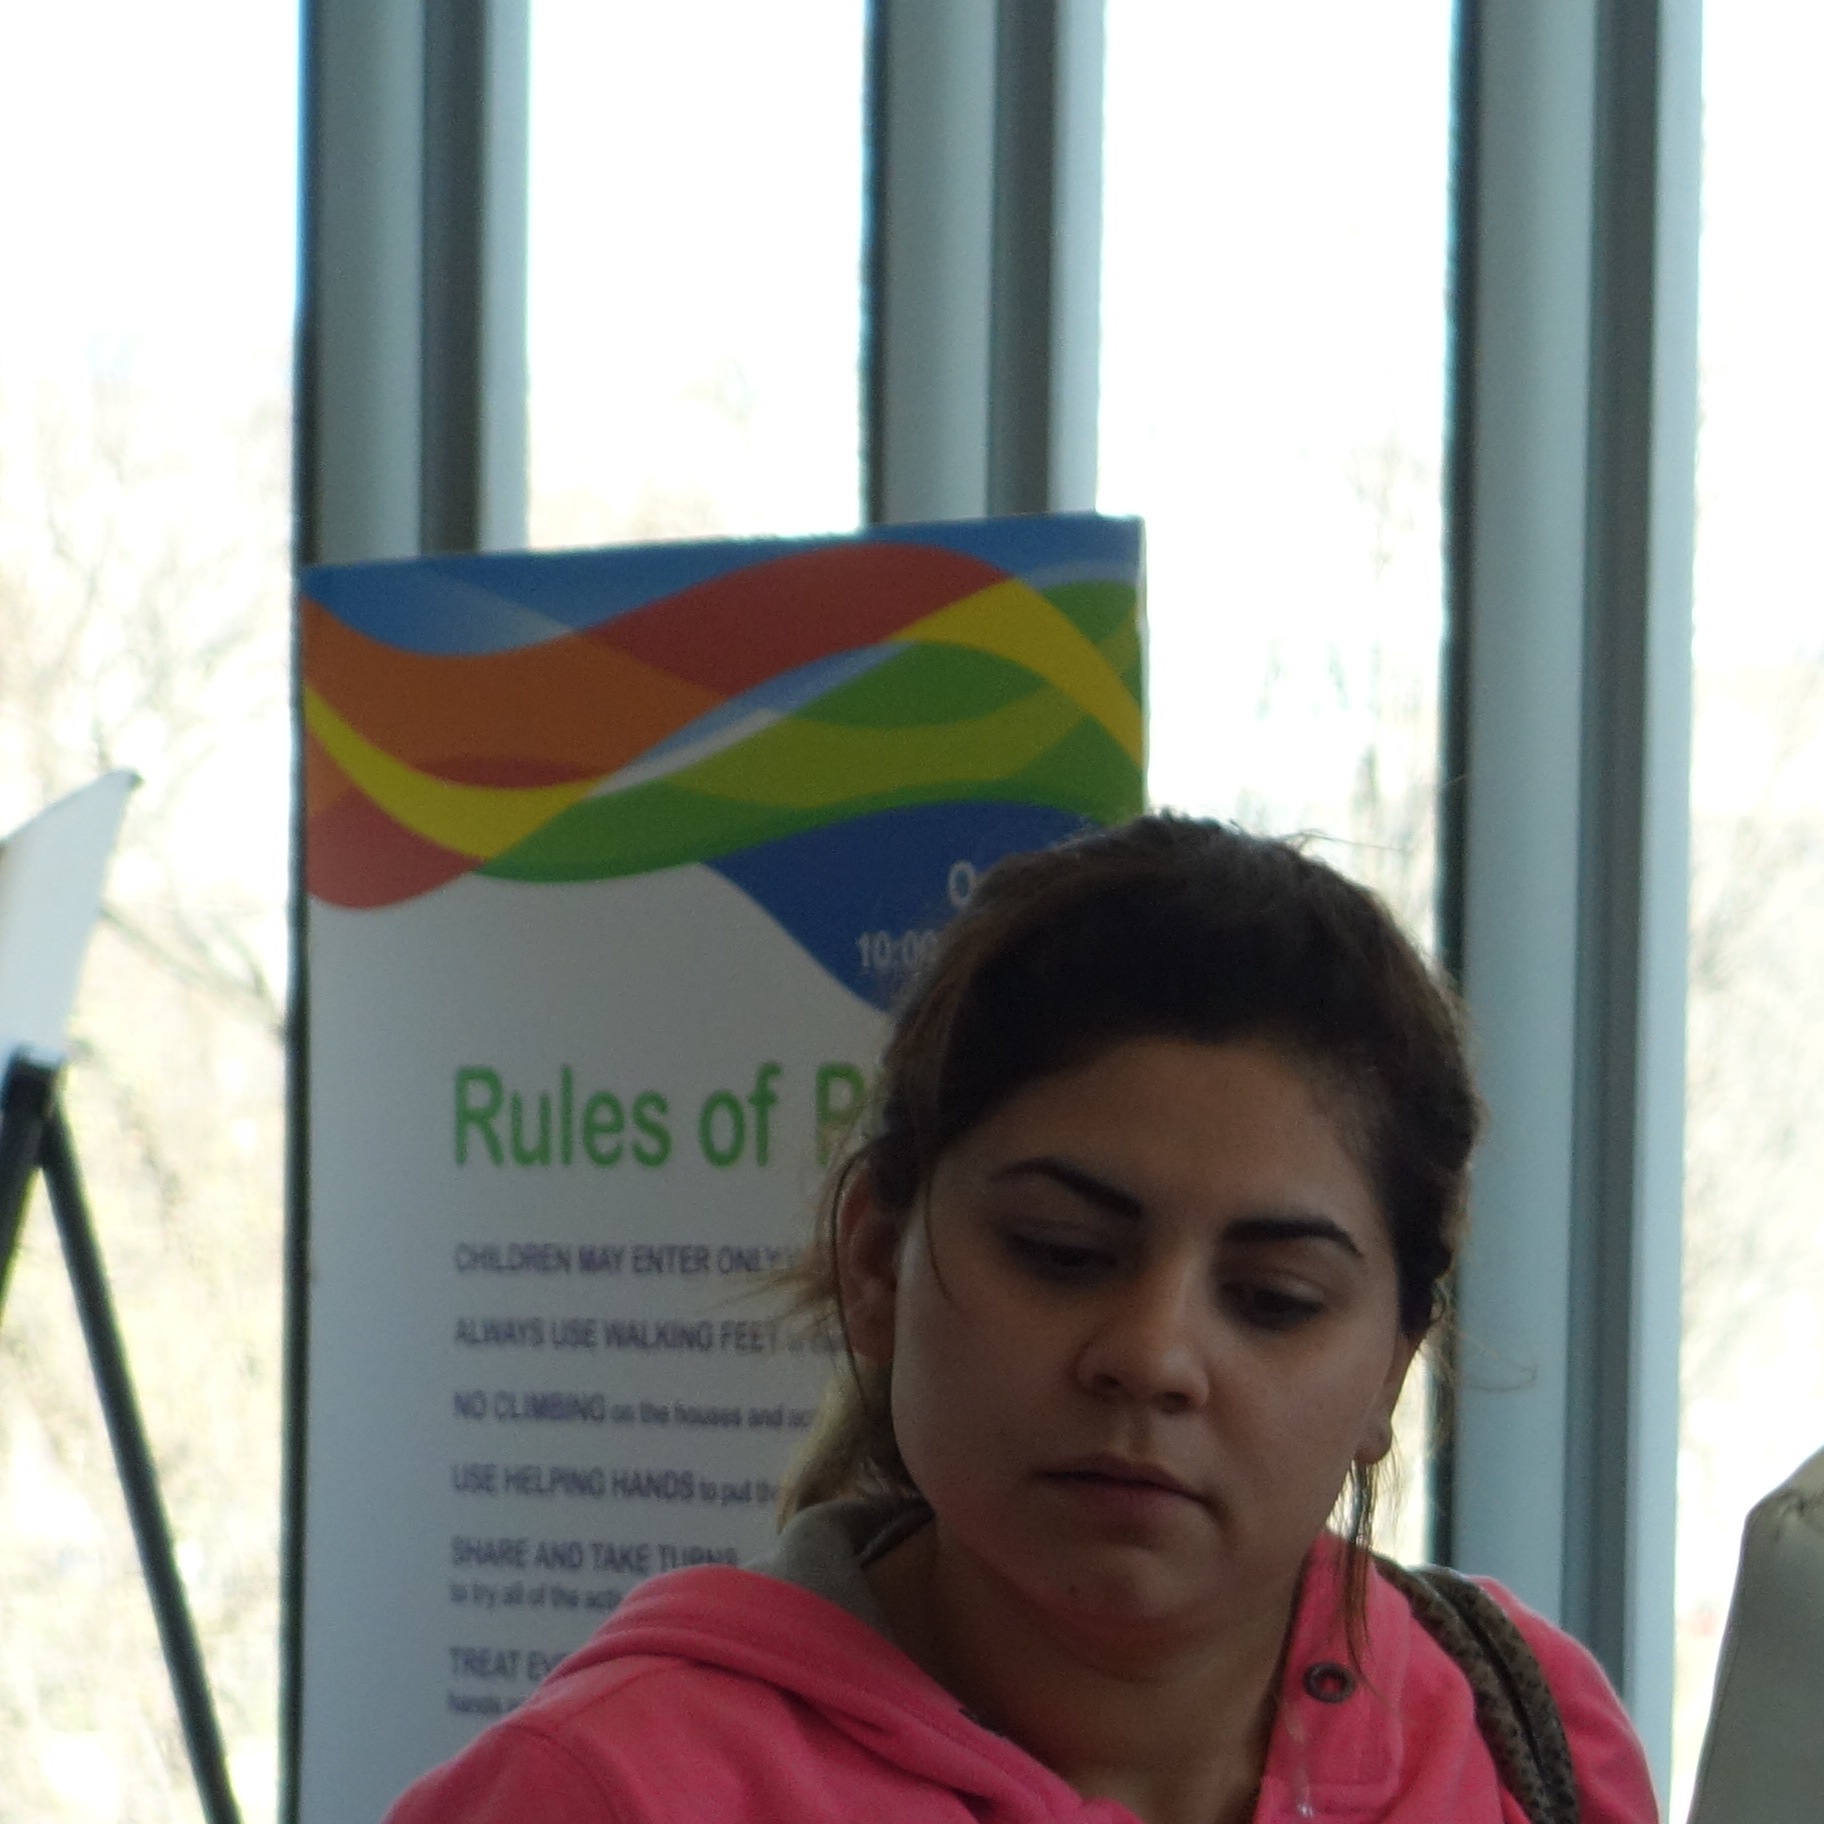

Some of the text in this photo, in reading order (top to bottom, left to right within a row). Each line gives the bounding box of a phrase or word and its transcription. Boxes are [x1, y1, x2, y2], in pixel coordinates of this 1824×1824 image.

[454, 1064, 673, 1168] Rules
[698, 1061, 783, 1168] of
[454, 1241, 571, 1275] CHILDREN
[577, 1243, 622, 1274] MAY
[631, 1244, 710, 1277] ENTER
[454, 1316, 545, 1350] ALWAYS
[550, 1318, 597, 1351] USE
[603, 1319, 715, 1352] WALKING
[453, 1390, 488, 1420] NO
[493, 1390, 606, 1423] CLIMBING
[453, 1463, 497, 1495] USE
[503, 1464, 605, 1498] HELPING
[611, 1468, 695, 1503] HANDS
[452, 1535, 528, 1568] SHARE
[535, 1539, 584, 1571] AND
[592, 1542, 651, 1574] TAKE
[448, 1646, 520, 1679] TREAT
